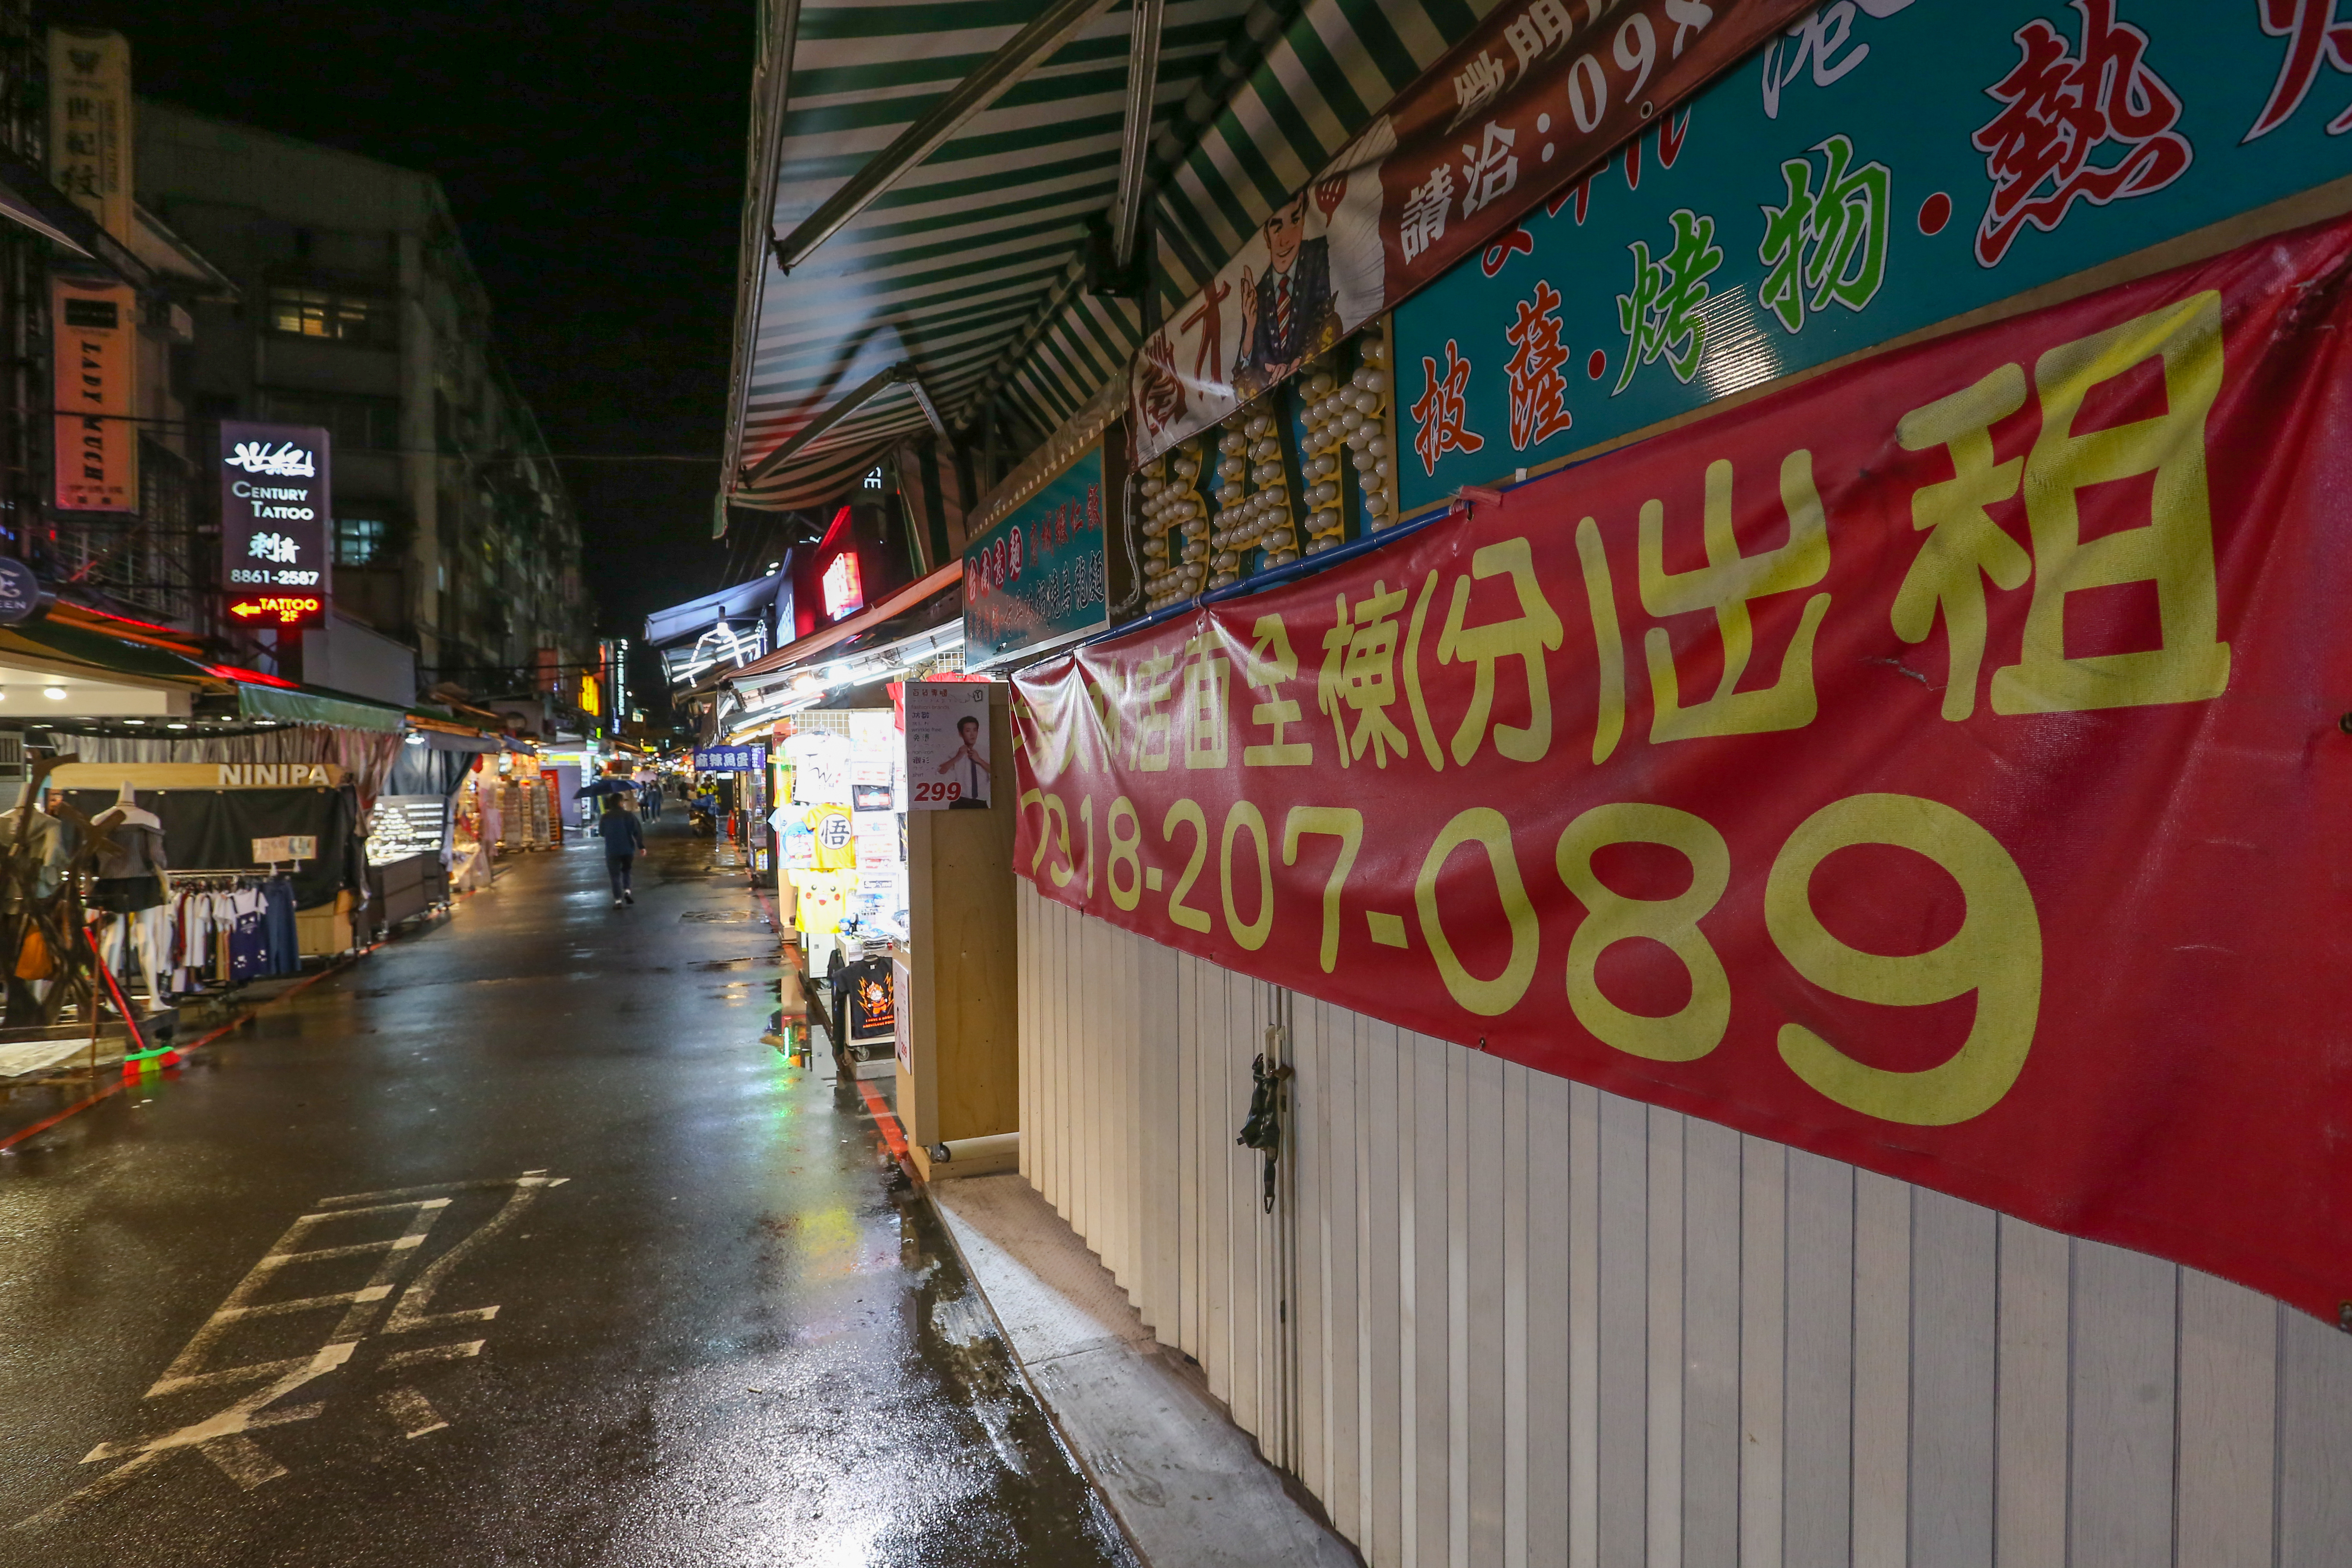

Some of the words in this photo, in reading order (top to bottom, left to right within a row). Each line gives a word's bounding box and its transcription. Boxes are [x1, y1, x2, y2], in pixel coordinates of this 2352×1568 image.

[81, 340, 102, 404] LADY
[83, 416, 104, 482] MUCH
[232, 480, 309, 501] CENTURY
[251, 501, 315, 520] TATTOO
[248, 531, 301, 564] 刺青
[231, 569, 319, 586] 8861-2587
[259, 598, 318, 611] TATTOO
[280, 610, 299, 622] 2F
[695, 752, 749, 767] 麻辣魚蛋
[218, 764, 330, 785] NINIPA
[914, 781, 962, 802] 299
[821, 819, 850, 845] 悟
